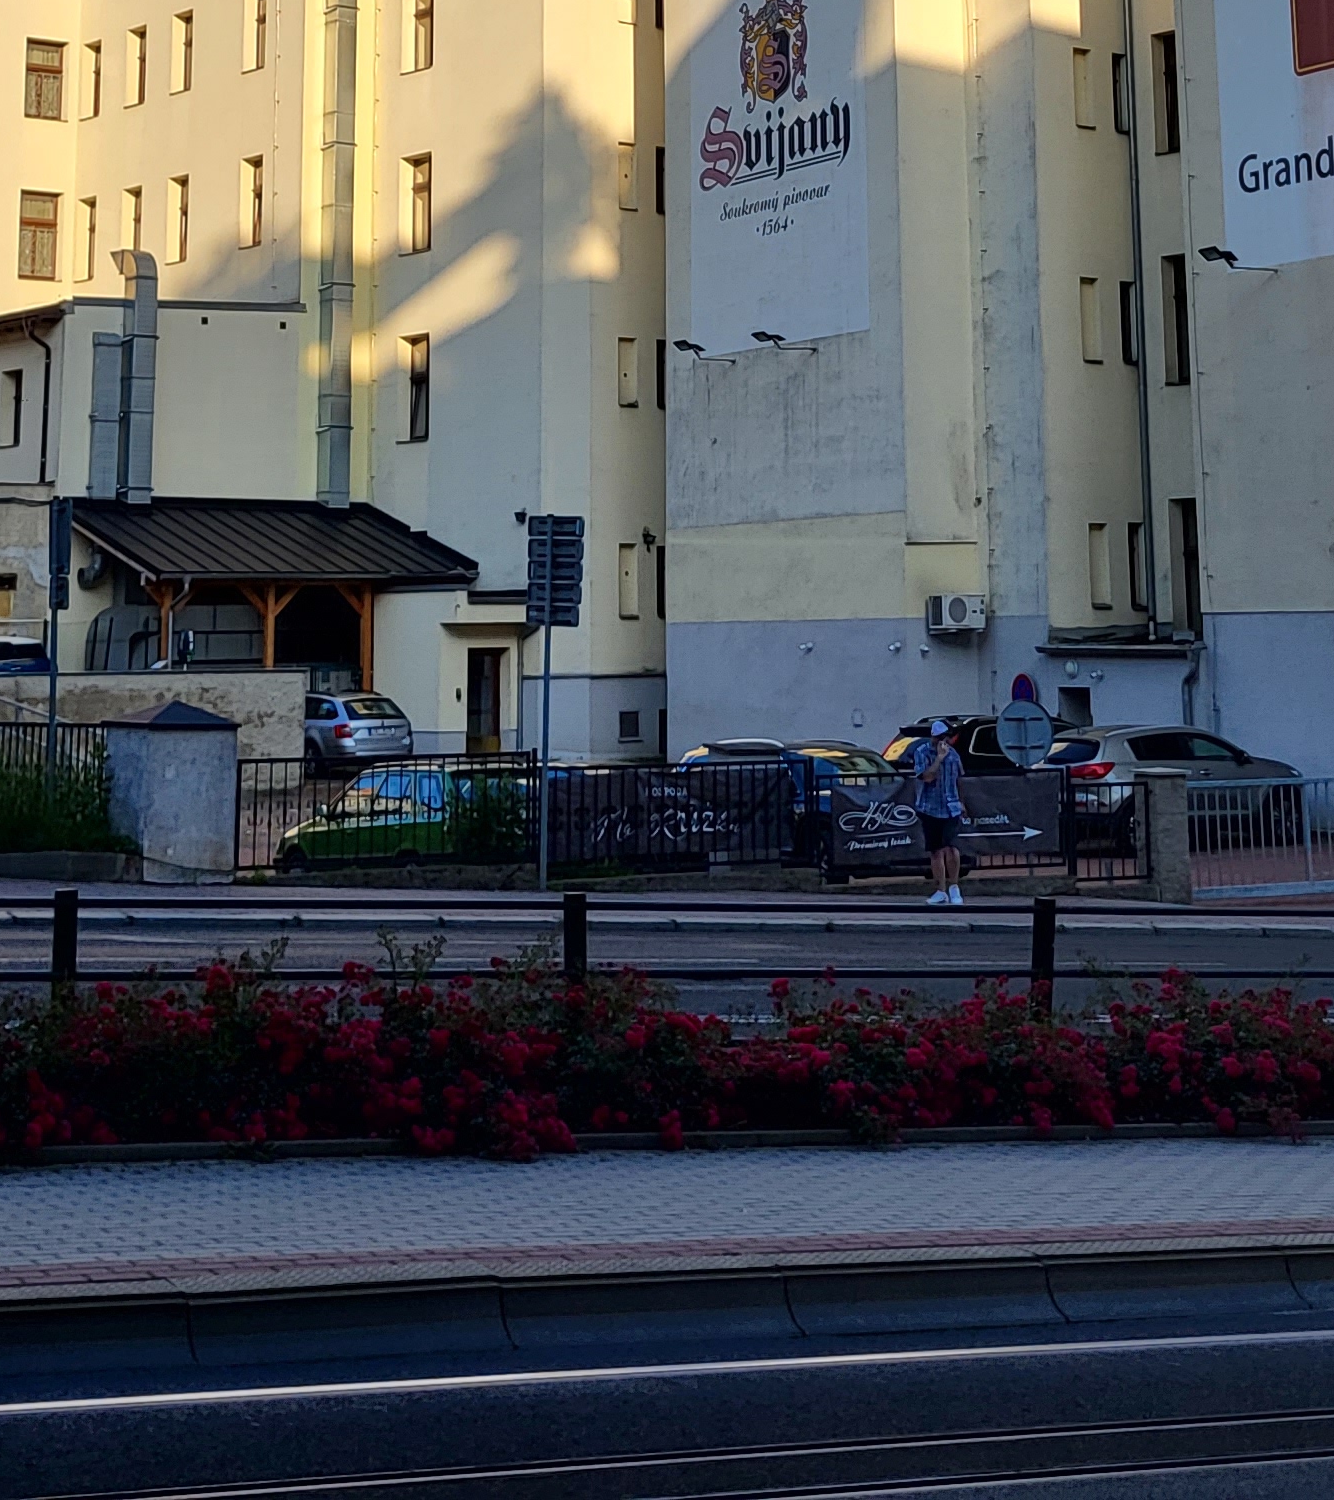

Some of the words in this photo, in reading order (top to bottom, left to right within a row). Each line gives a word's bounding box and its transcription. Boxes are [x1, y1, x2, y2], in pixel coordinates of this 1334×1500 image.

[699, 97, 851, 192] Svijany
[719, 190, 779, 222] Soukromý
[782, 182, 831, 211] pivovar
